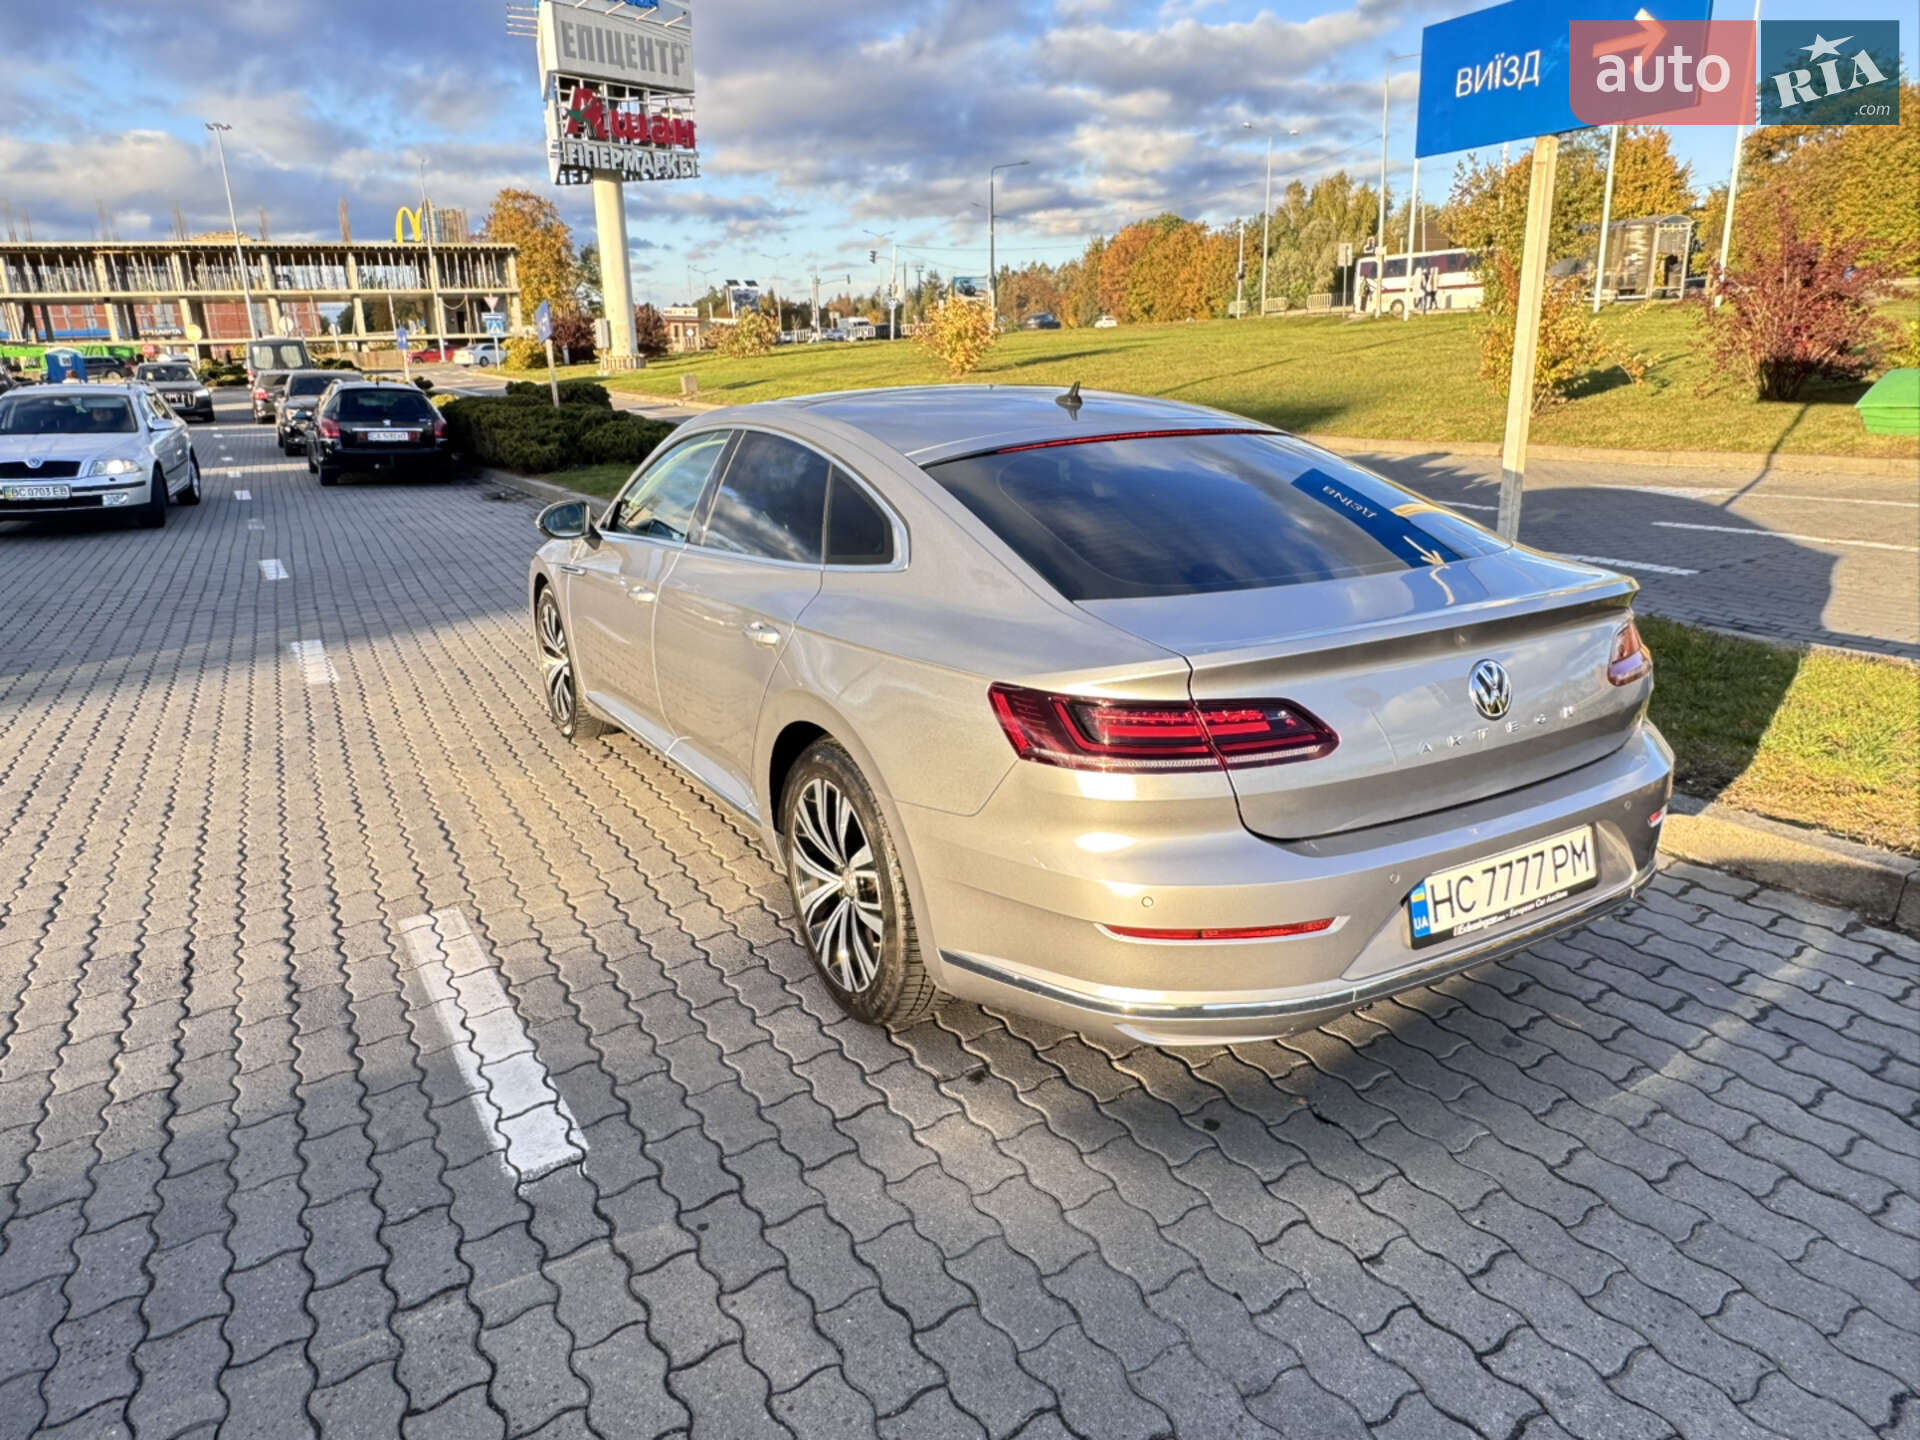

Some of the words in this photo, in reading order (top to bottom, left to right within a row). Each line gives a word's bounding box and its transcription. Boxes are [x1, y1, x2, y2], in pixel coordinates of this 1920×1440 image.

[561, 20, 688, 76] ЕПІЦЕНТР
[1455, 48, 1541, 98] ВИЇЗД
[1413, 916, 1429, 931] UA
[1430, 875, 1476, 924] HC
[1482, 851, 1546, 906] 7777
[1552, 835, 1589, 883] PM
